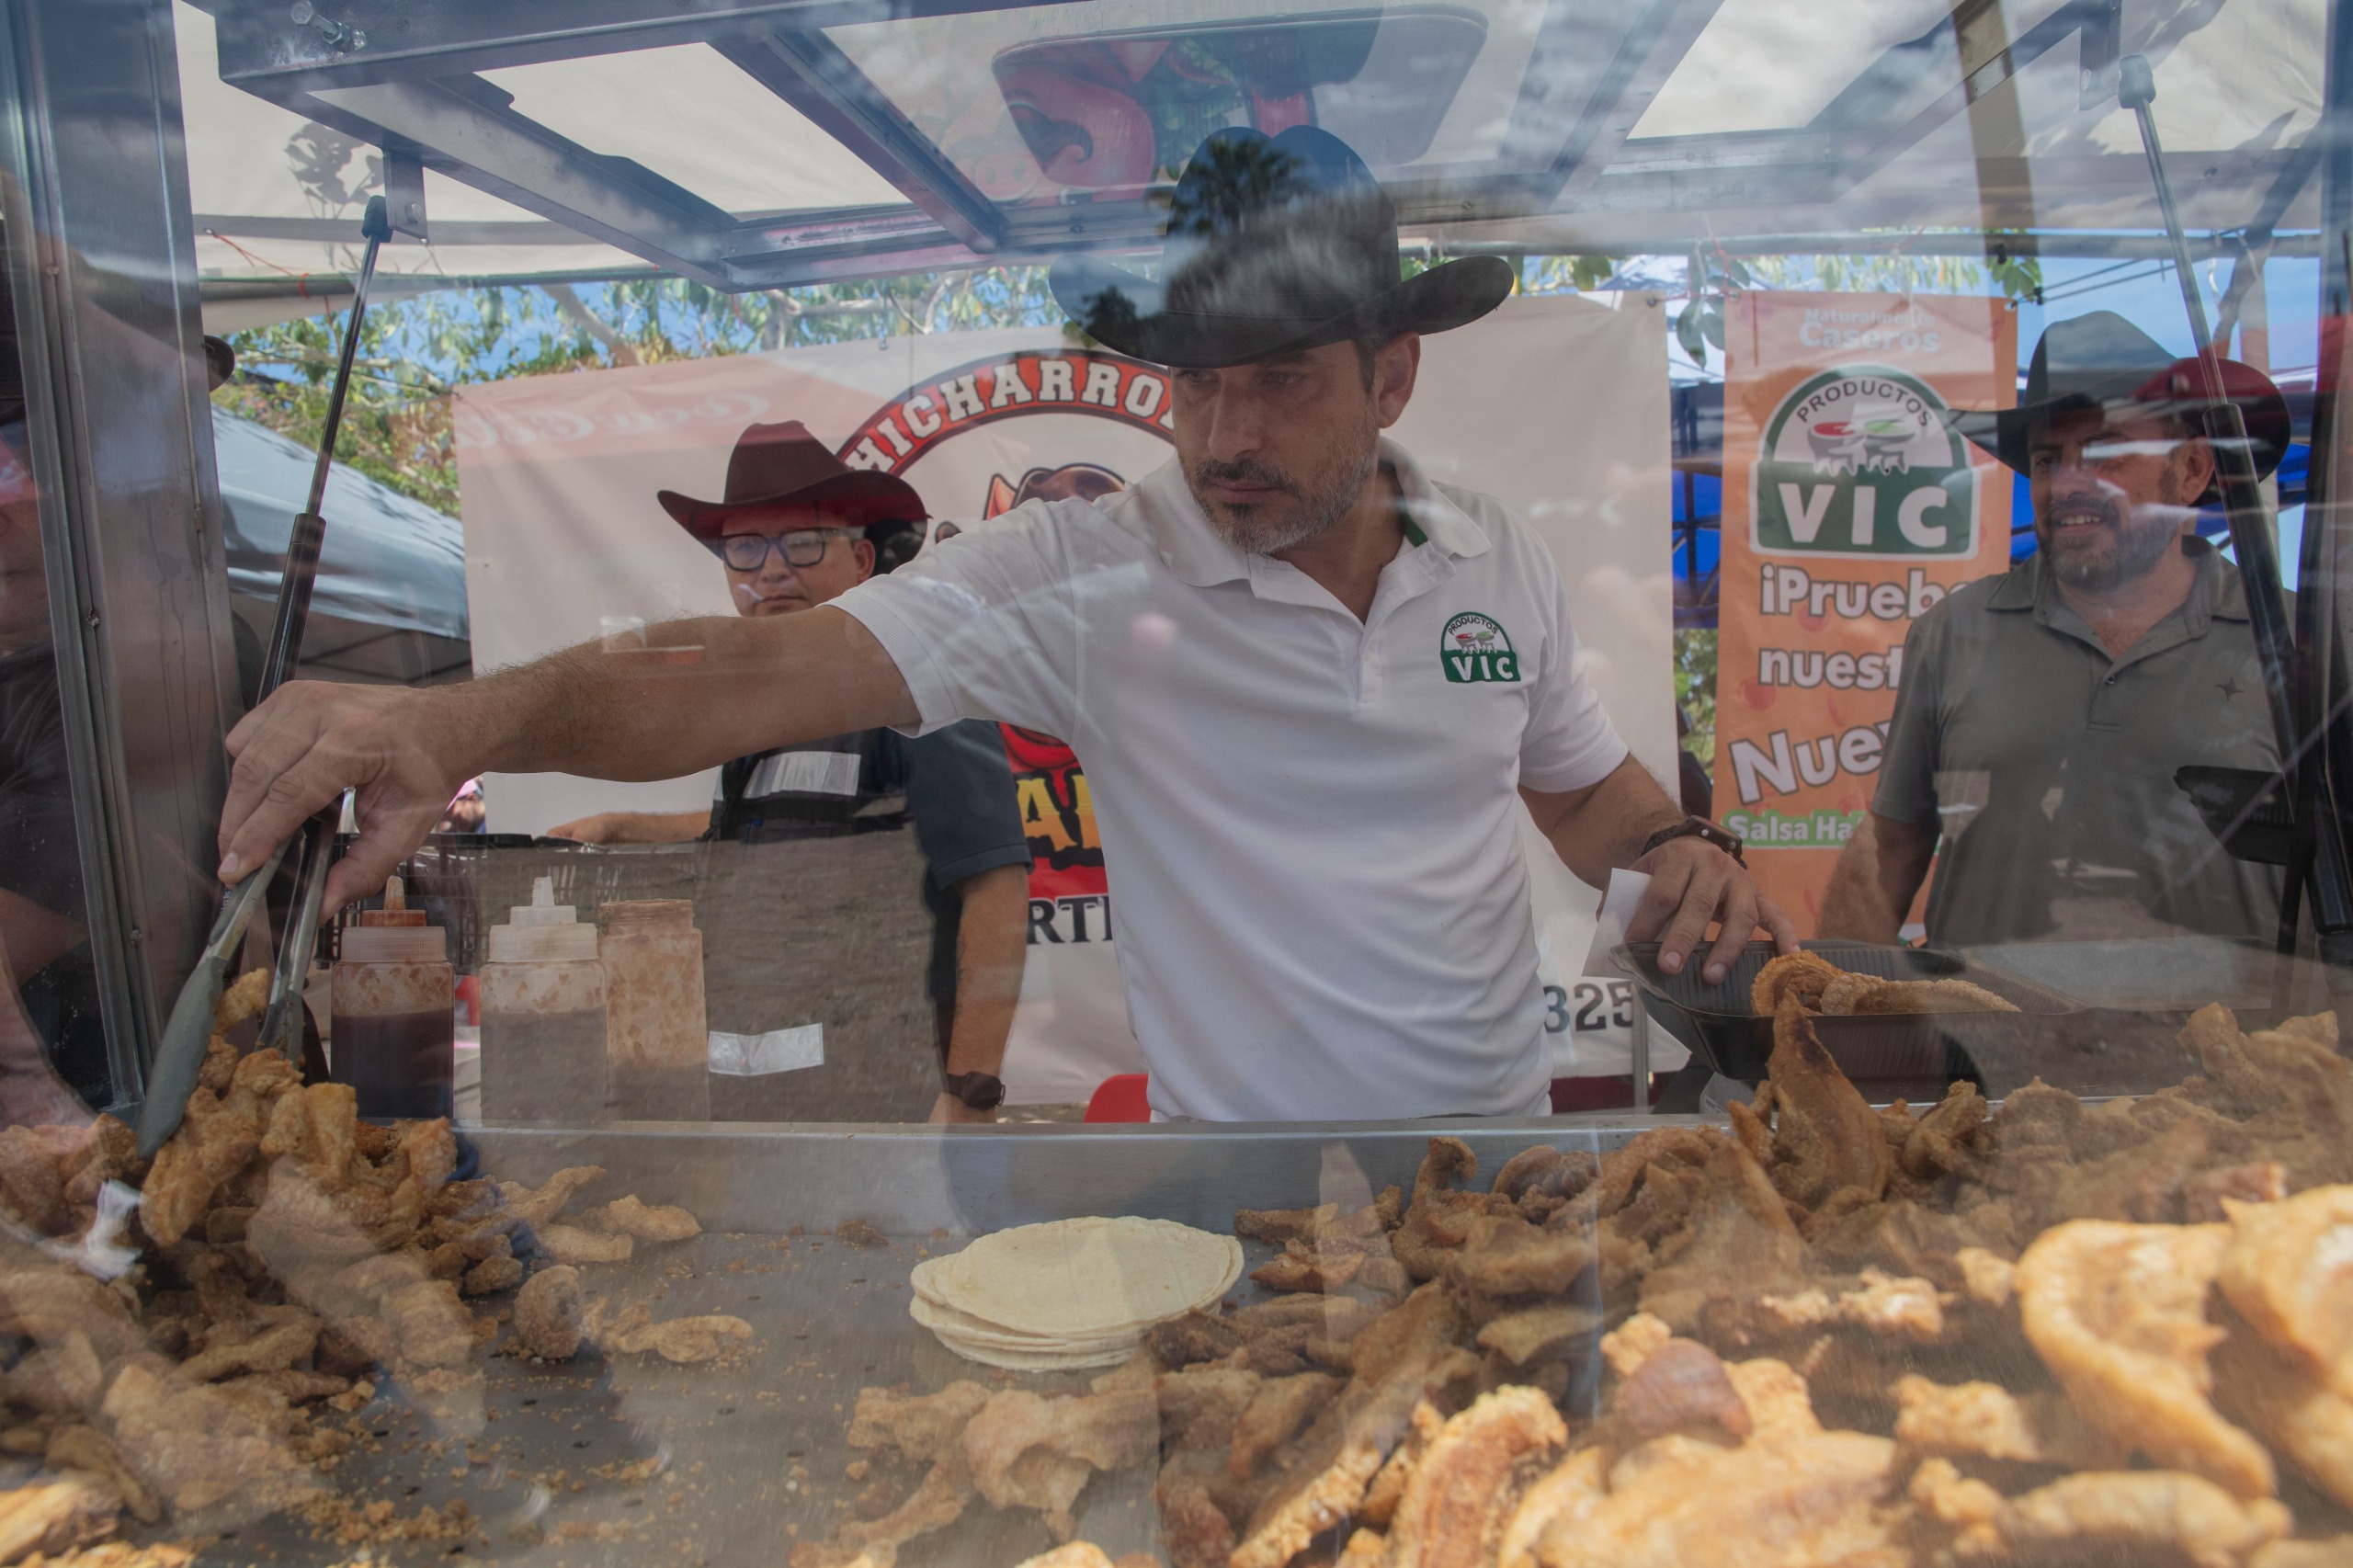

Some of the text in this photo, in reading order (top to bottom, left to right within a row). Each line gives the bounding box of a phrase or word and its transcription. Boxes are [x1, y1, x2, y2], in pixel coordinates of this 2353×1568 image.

[1804, 308, 1937, 326] Naturalmente
[1798, 321, 1939, 353] Caseros
[844, 358, 1176, 472] HICHARRO
[1796, 380, 1932, 427] PRODUCTOS
[1777, 482, 1949, 549] VIC
[1448, 615, 1499, 636] PRODUCTOS
[1450, 655, 1514, 681] VIC
[1727, 720, 1893, 806] Nue
[1727, 813, 1862, 842] Salsa Ha
